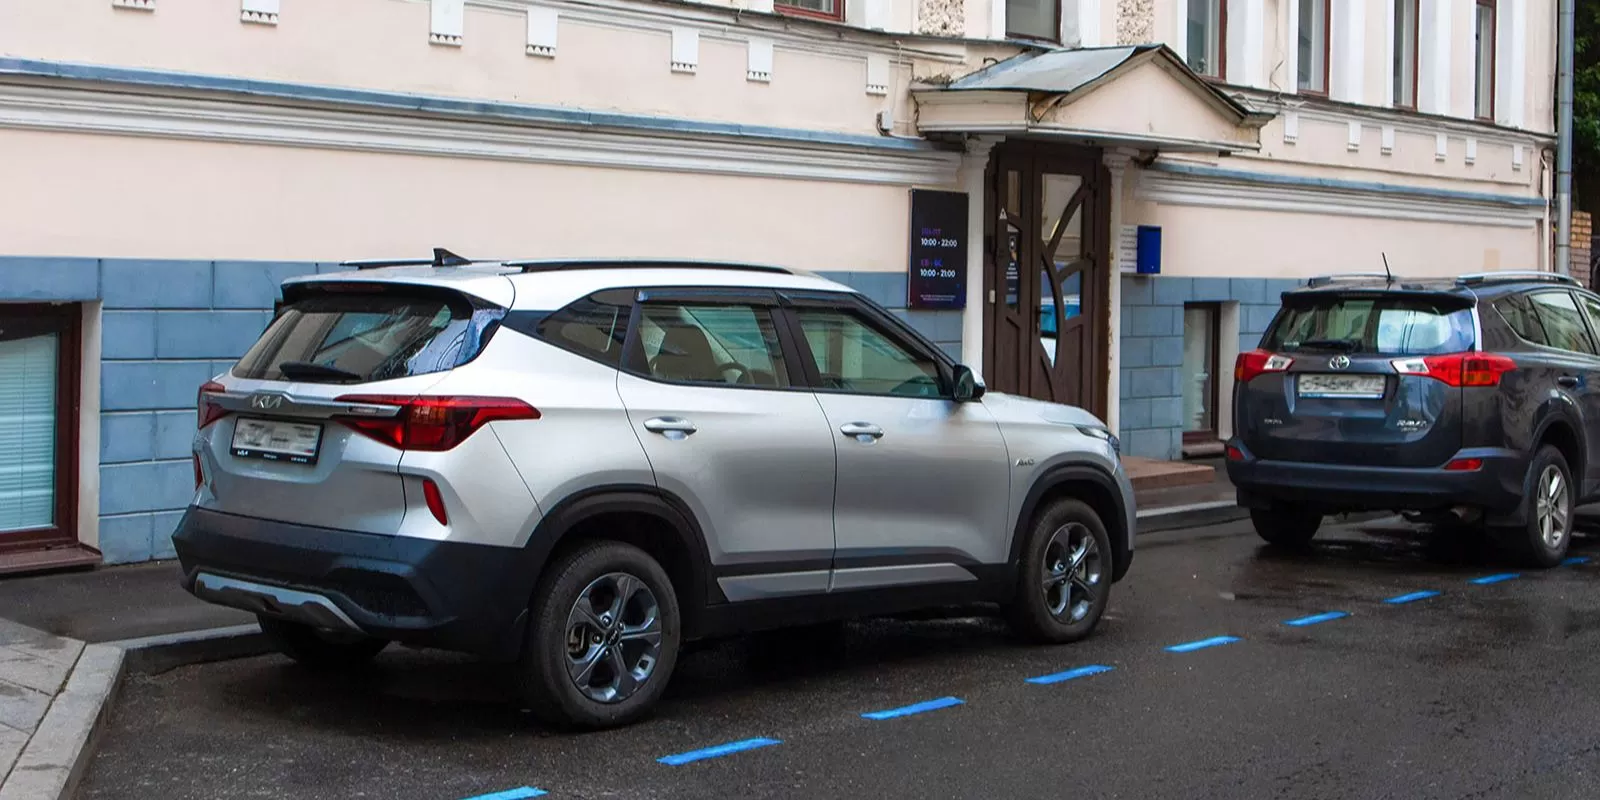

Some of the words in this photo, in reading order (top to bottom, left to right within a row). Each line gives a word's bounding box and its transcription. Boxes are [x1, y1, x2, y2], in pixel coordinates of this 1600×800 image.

[921, 238, 937, 246] 10:00
[941, 239, 957, 247] 22:00
[920, 269, 936, 277] 10:00
[941, 269, 955, 277] 21:00
